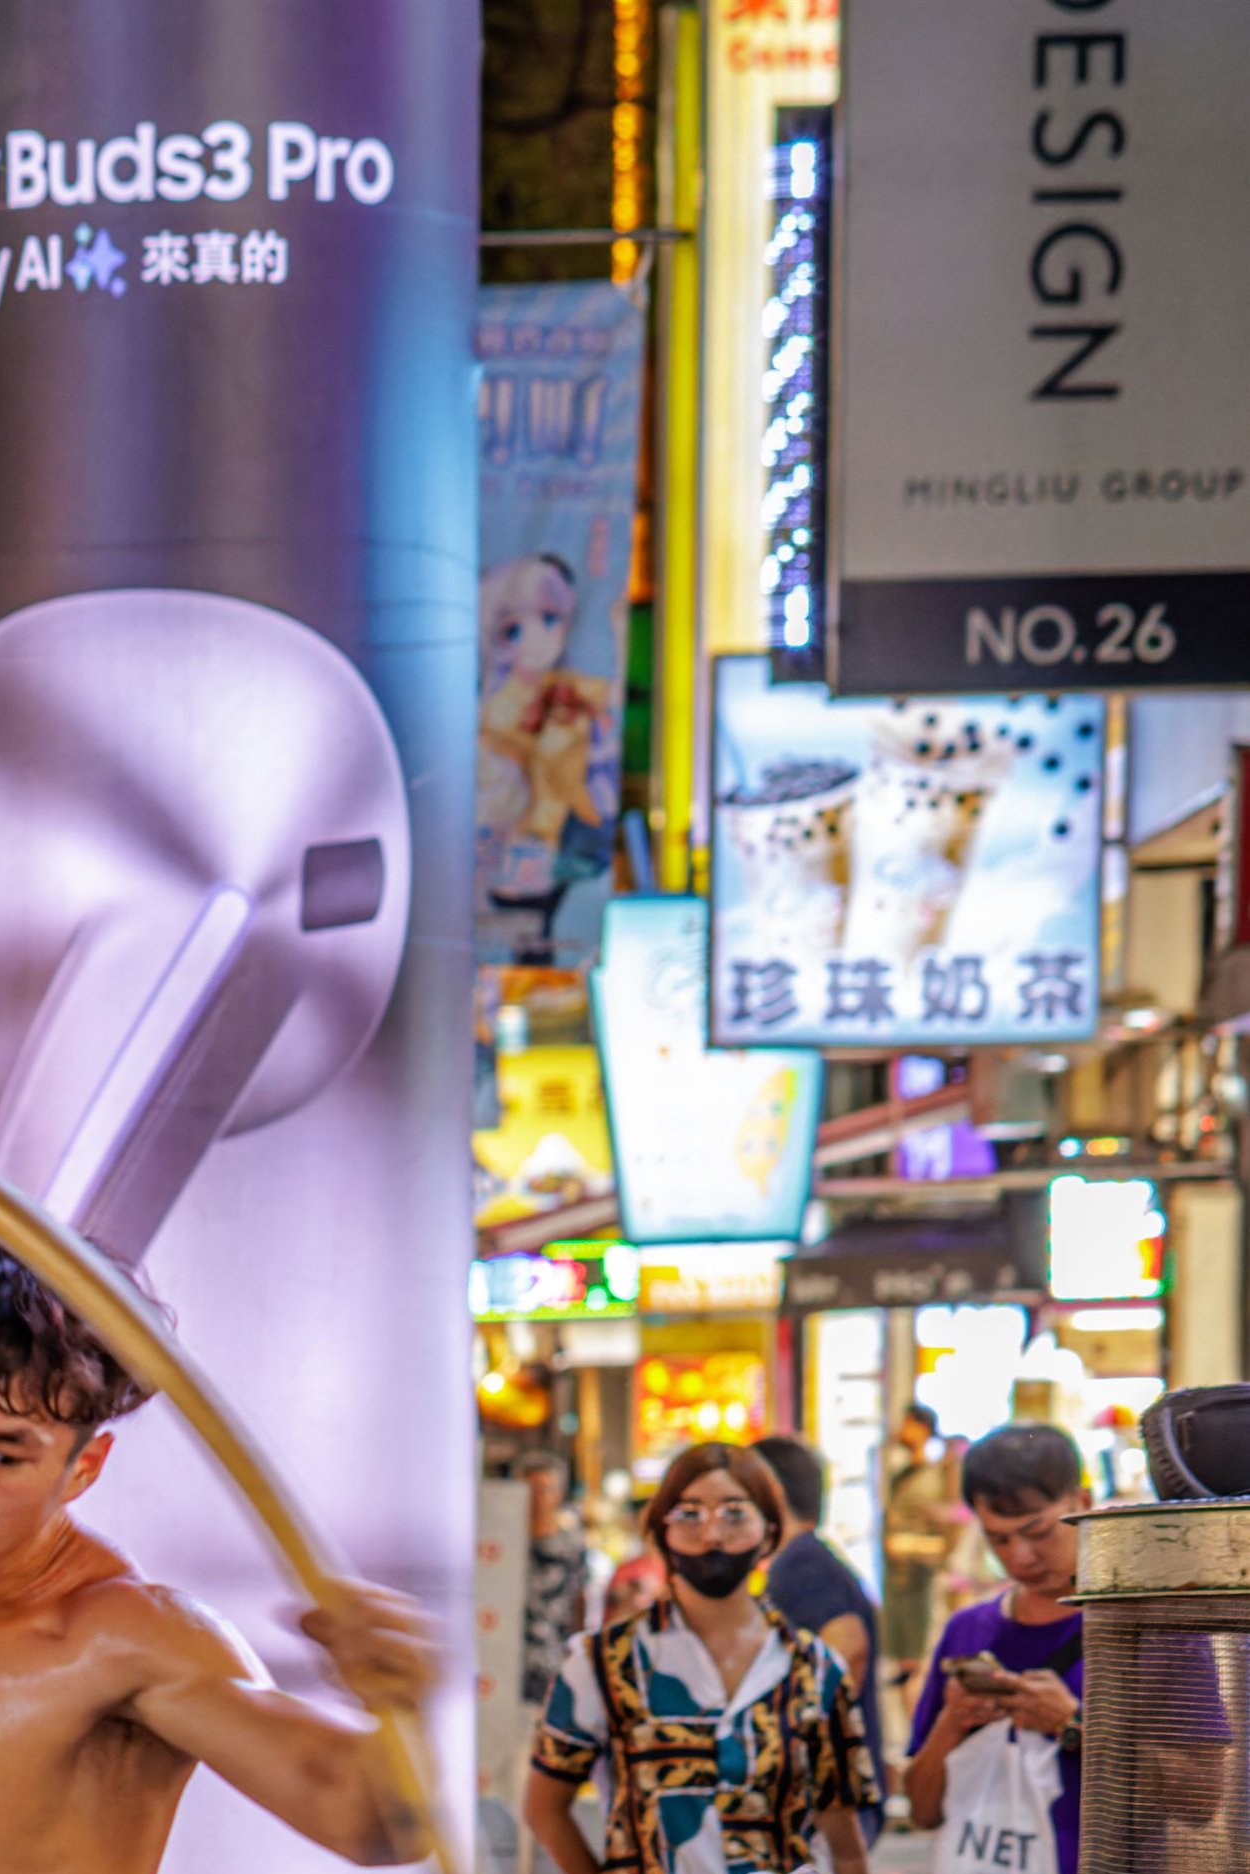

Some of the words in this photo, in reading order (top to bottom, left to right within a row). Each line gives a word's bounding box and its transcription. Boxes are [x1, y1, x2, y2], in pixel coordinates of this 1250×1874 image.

[5, 118, 252, 211] Buds3
[267, 120, 395, 205] Pro
[1029, 0, 1127, 401] ESIGN
[14, 233, 64, 292] AI
[140, 227, 288, 286] 來真的
[904, 471, 1079, 506] MINGLIU
[1102, 467, 1244, 502] GROUP
[965, 602, 1177, 667] NO.26
[727, 953, 1085, 1026] 珍珠奶茶
[955, 1819, 1038, 1872] NET
